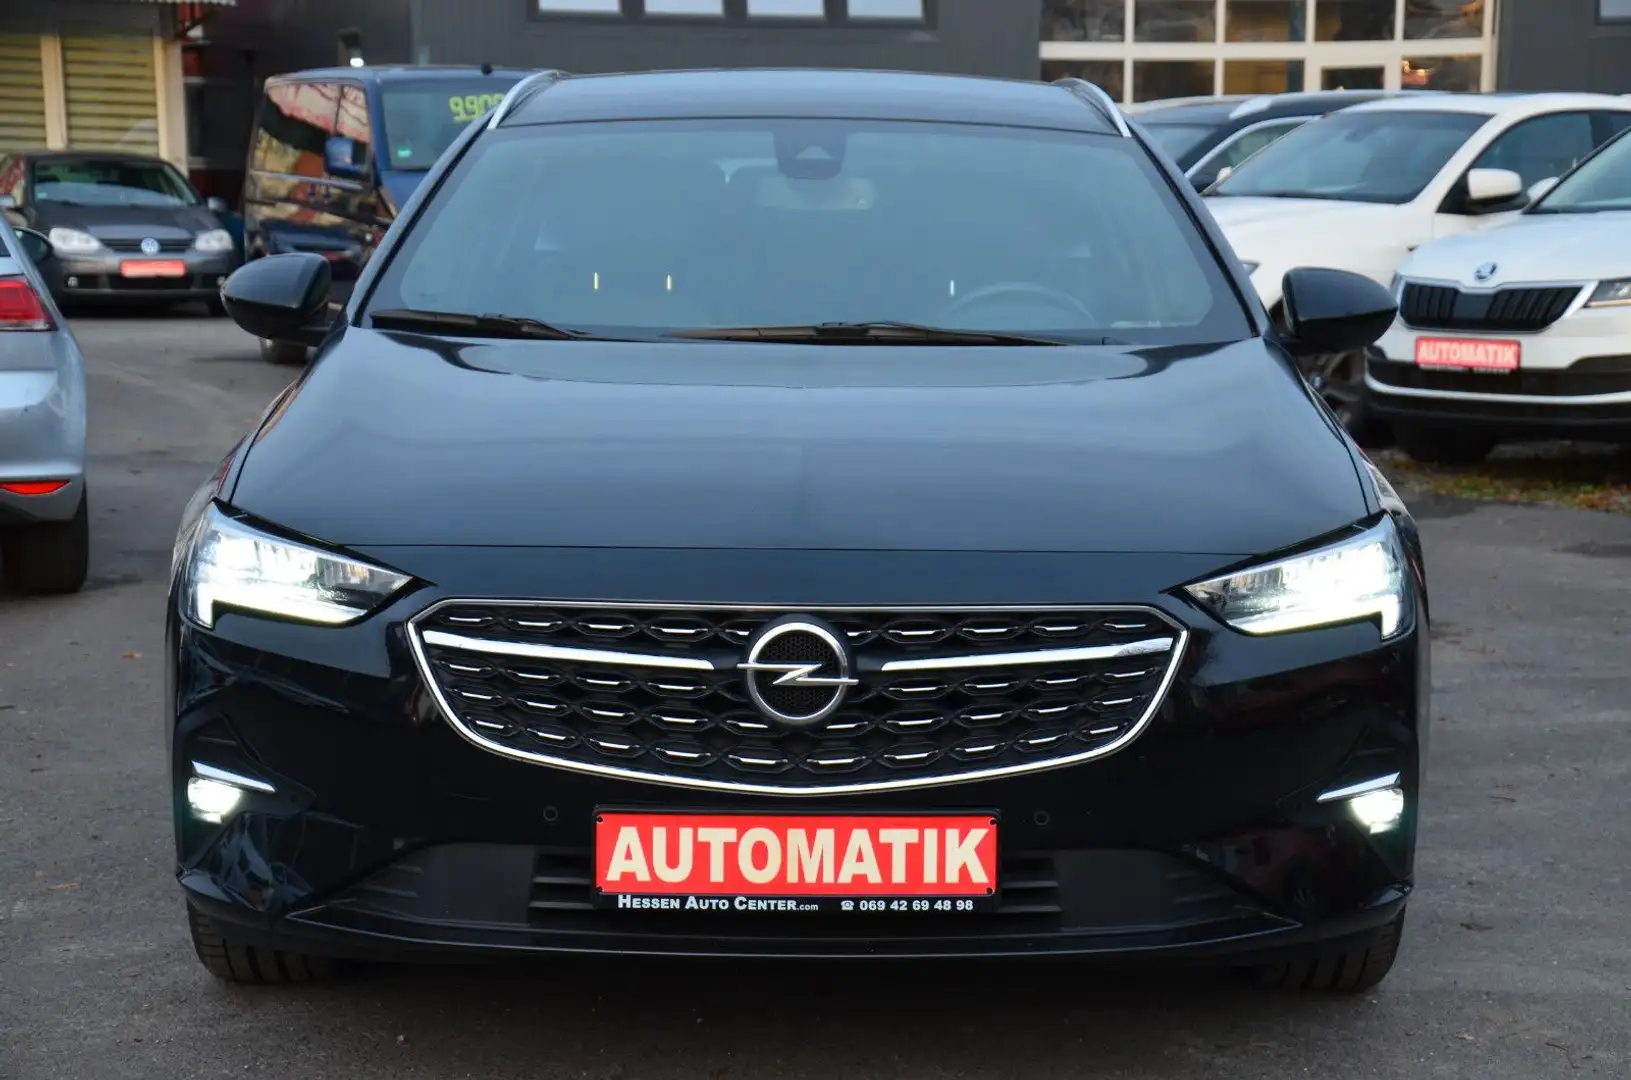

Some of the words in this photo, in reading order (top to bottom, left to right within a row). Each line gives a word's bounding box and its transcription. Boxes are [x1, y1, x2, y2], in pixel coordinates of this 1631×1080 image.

[1420, 341, 1516, 365] AUTOMATIK
[606, 826, 989, 884] AUTOMATIK
[617, 894, 679, 909] HESSEN
[685, 896, 730, 910] AUTO
[859, 900, 885, 911] 069
[890, 900, 908, 911] 42
[912, 900, 929, 911] 69
[934, 900, 951, 911] 48
[956, 900, 974, 911] 98
